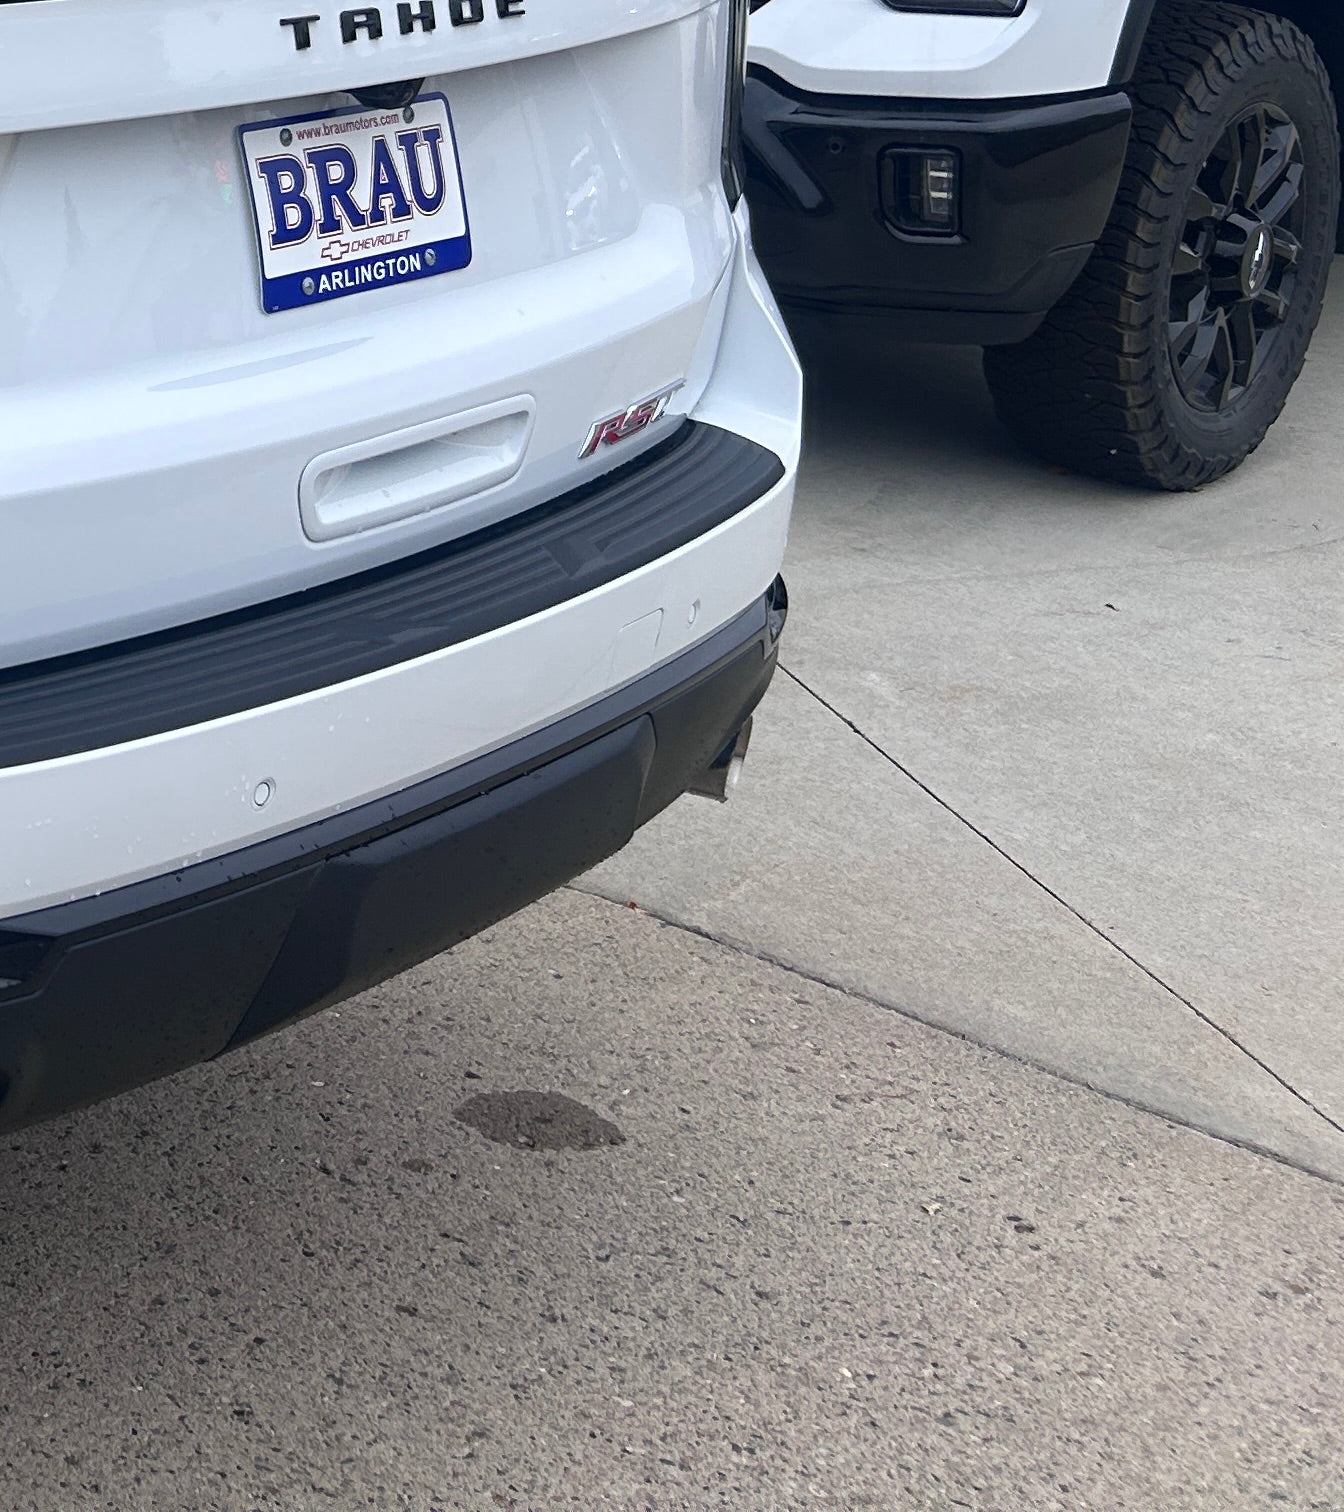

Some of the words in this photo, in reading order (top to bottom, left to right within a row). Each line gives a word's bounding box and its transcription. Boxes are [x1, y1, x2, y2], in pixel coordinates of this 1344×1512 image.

[295, 112, 400, 141] www.braumotors.com
[255, 123, 445, 251] BRAU
[350, 229, 411, 253] CHEVROLET
[318, 252, 421, 294] ARLINGTON
